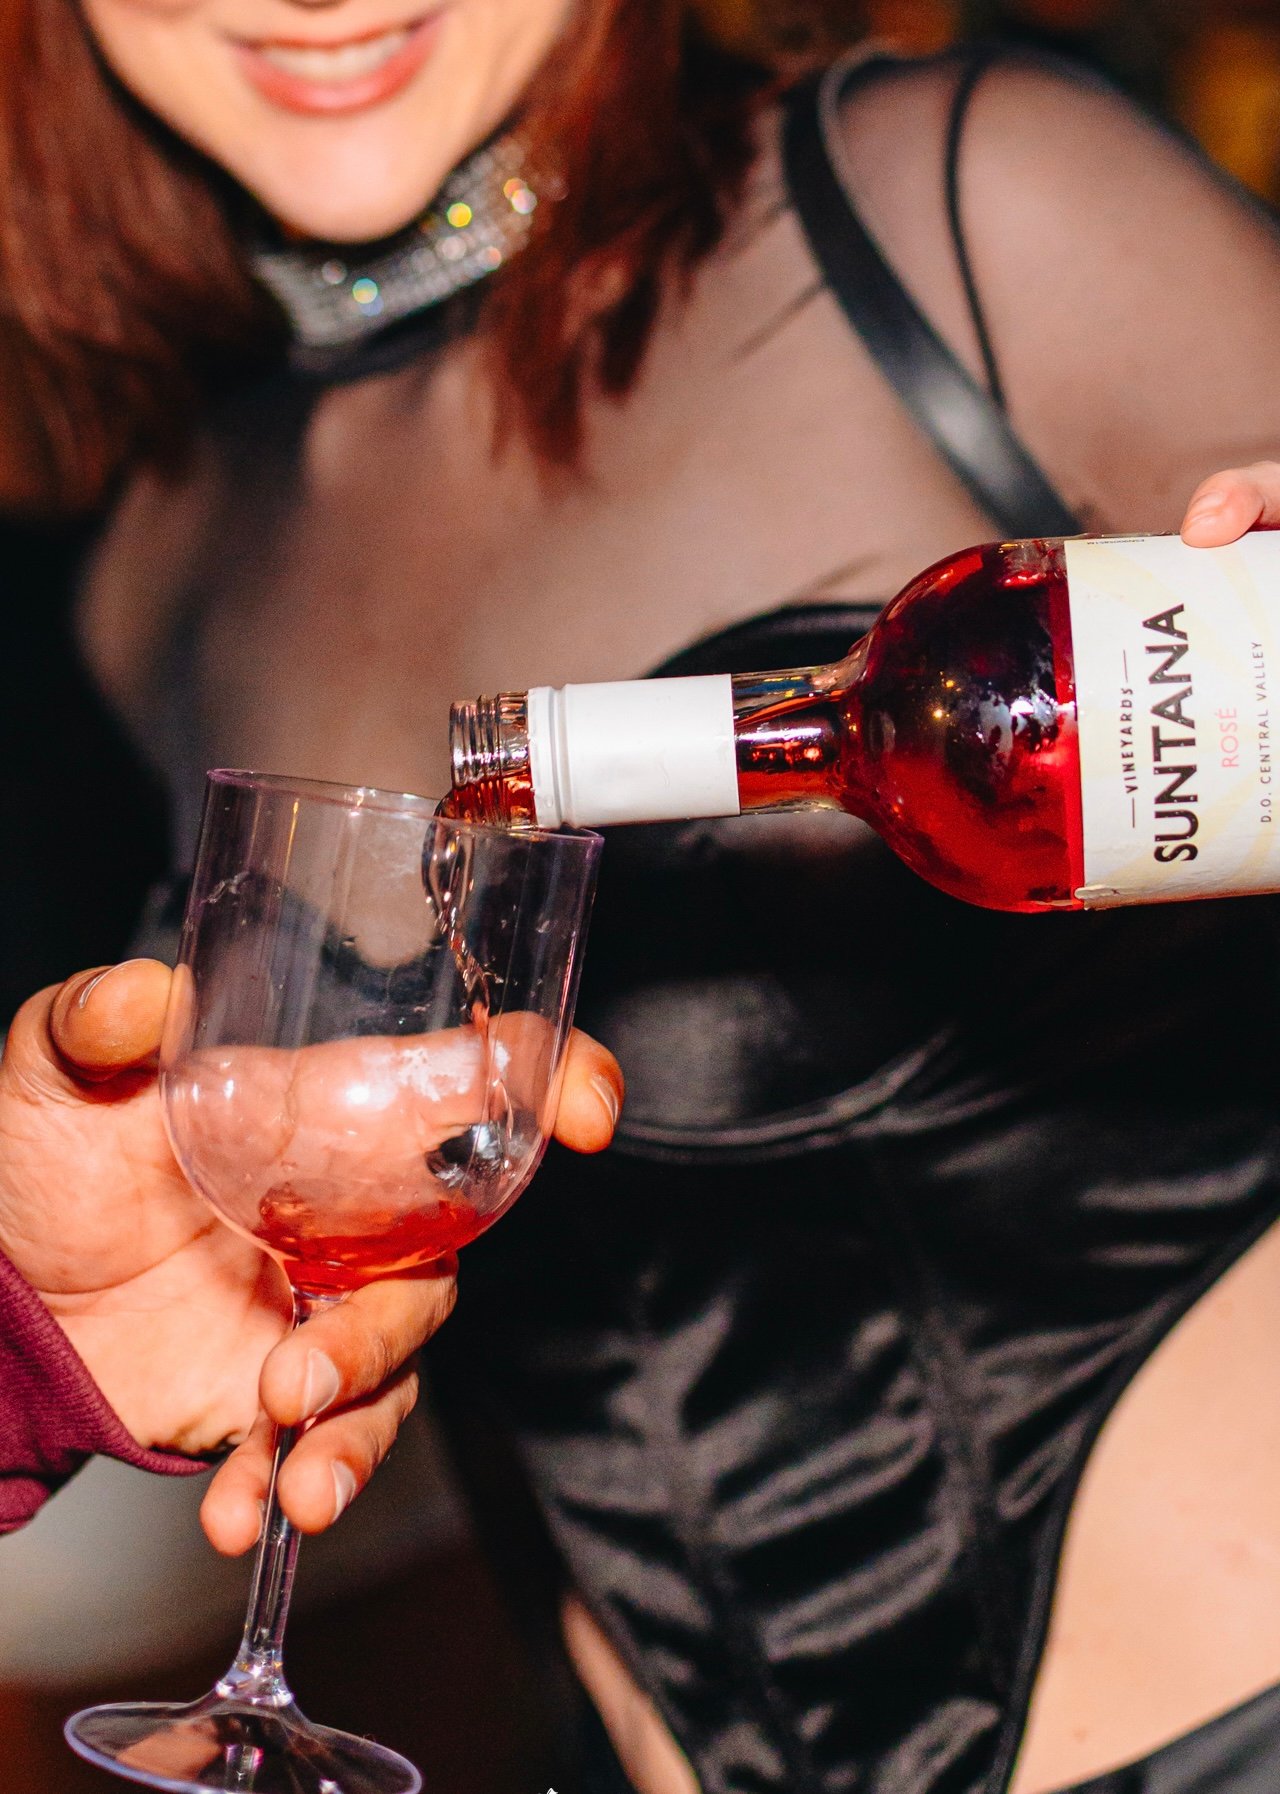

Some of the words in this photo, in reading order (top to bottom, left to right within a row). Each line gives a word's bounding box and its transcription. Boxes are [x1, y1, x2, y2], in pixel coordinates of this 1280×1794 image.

[1251, 641, 1268, 701] VALLEY
[1120, 687, 1139, 795] VINEYARDS
[1142, 603, 1199, 863] SUNTANA
[1214, 707, 1239, 769] ROSÉ
[1258, 709, 1272, 784] CENTRAL
[1260, 792, 1272, 823] D.O.
